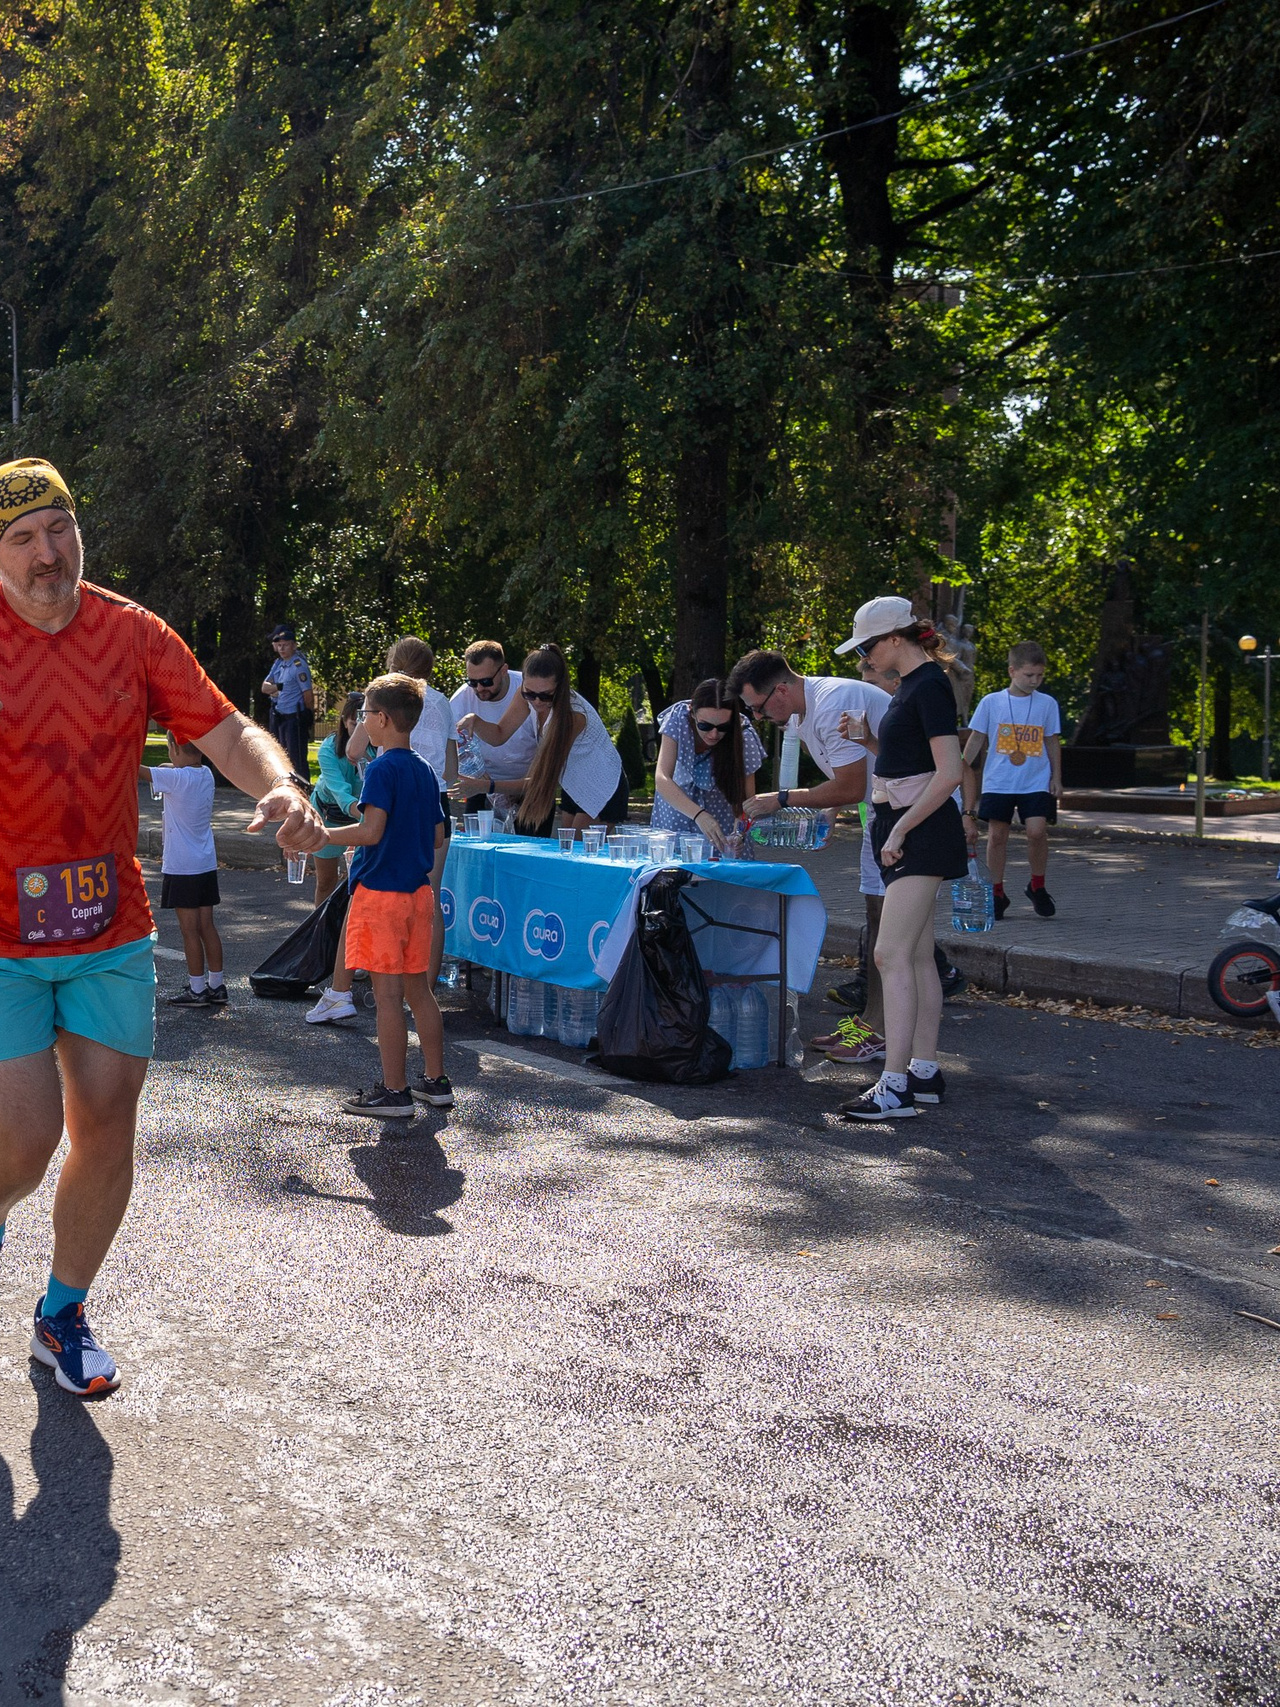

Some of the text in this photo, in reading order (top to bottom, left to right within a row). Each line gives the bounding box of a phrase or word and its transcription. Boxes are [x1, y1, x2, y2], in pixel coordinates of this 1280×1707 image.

[1015, 726, 1039, 742] 560
[60, 862, 110, 904] 153
[71, 902, 103, 920] Сергей
